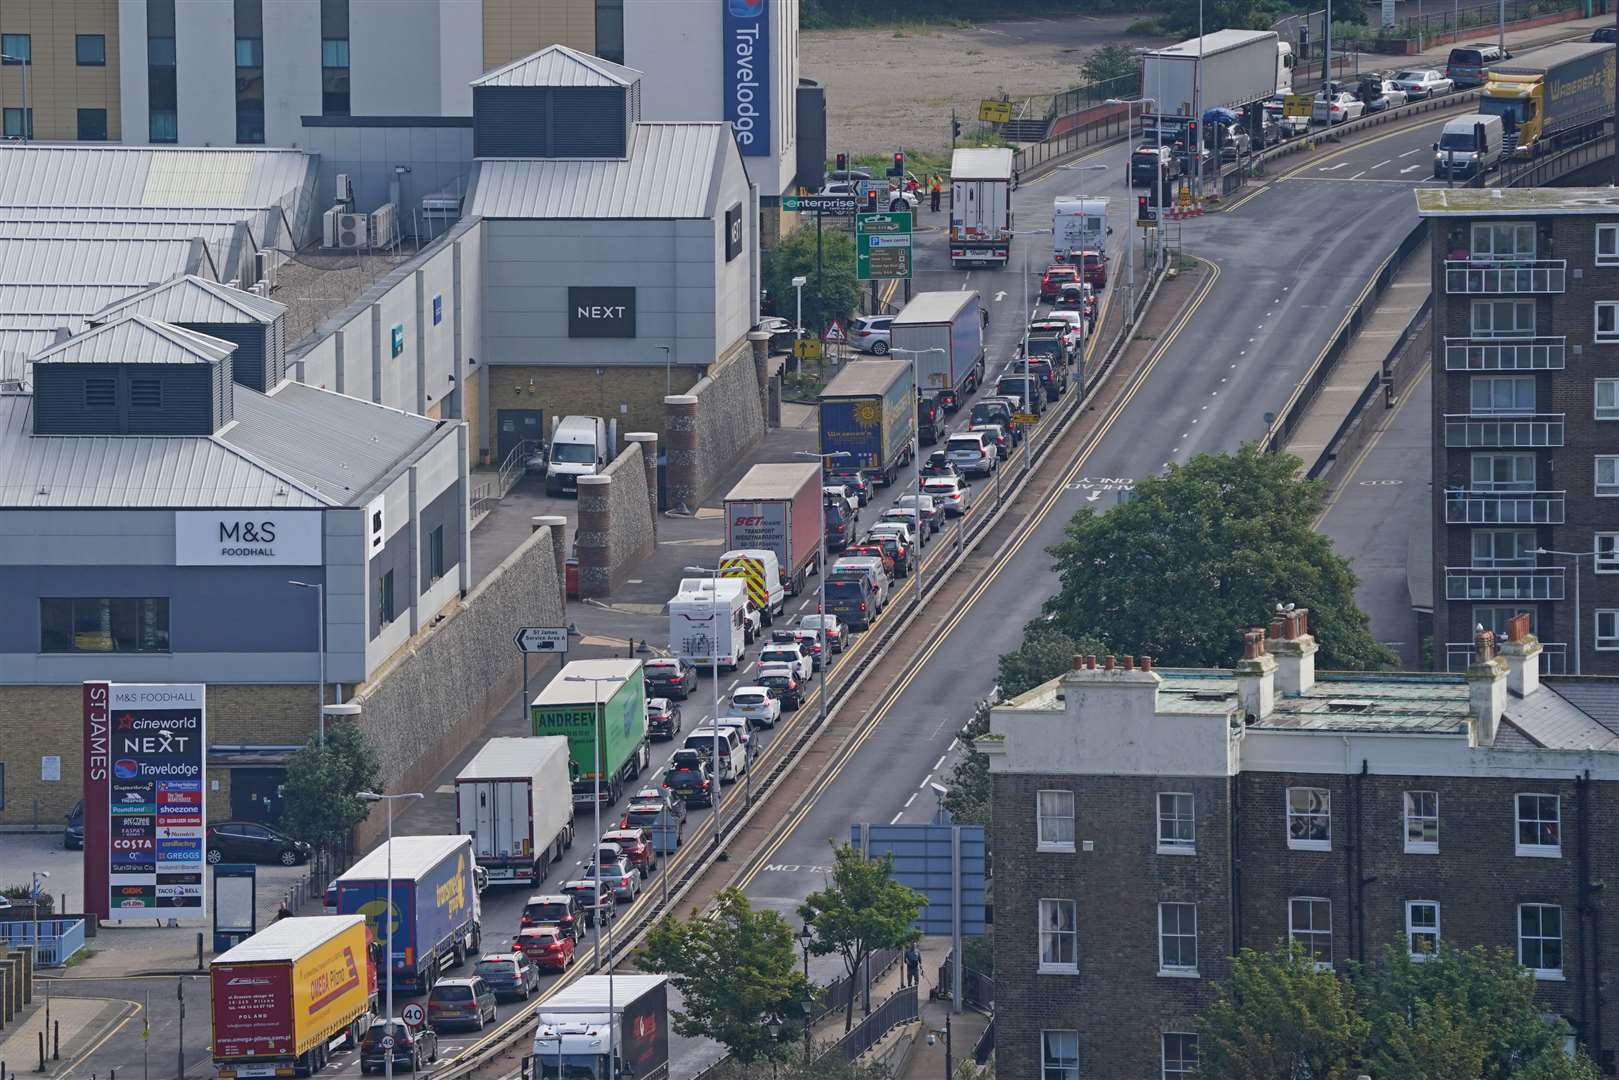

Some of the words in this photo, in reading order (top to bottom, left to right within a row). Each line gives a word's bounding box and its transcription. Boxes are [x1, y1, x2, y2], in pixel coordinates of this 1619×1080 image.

[732, 23, 759, 145] Travelodge
[785, 198, 855, 209] enterprise
[577, 306, 626, 318] NEXT
[735, 516, 764, 526] BET
[219, 521, 276, 543] M&S
[221, 547, 276, 556] FOODHALL
[115, 693, 137, 702] M&S
[140, 692, 195, 702] FOODHALL
[133, 716, 197, 729] cineworld
[538, 711, 596, 728] ANDREEV
[90, 713, 106, 780] JAMES
[124, 736, 189, 753] NEXT
[138, 762, 199, 776] Travelodge
[160, 805, 199, 813] shoezone
[113, 839, 152, 849] COSTA
[166, 852, 200, 860] GREGGS
[310, 970, 329, 1001] OMEGA
[404, 1009, 422, 1021] 40
